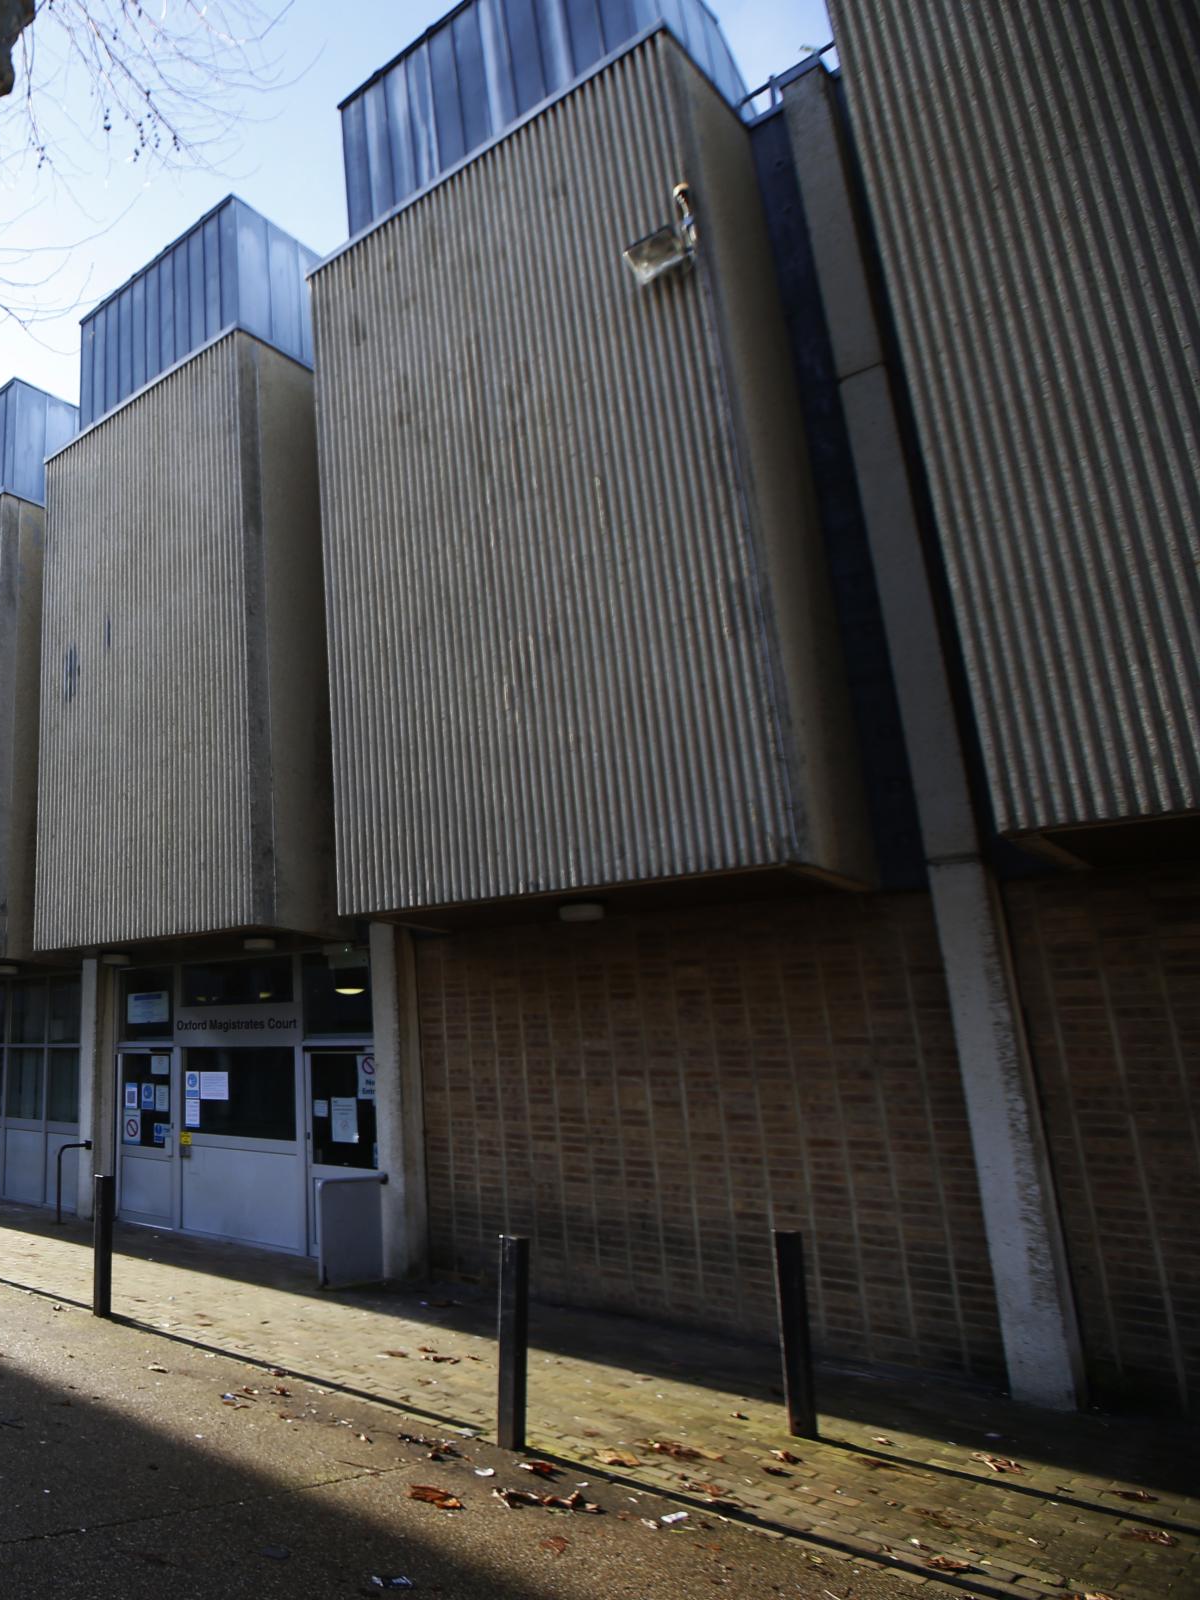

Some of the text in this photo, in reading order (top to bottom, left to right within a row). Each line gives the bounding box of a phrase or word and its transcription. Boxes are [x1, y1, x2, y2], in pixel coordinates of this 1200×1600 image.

[176, 1017, 297, 1032] Oxford Magistrates Court
